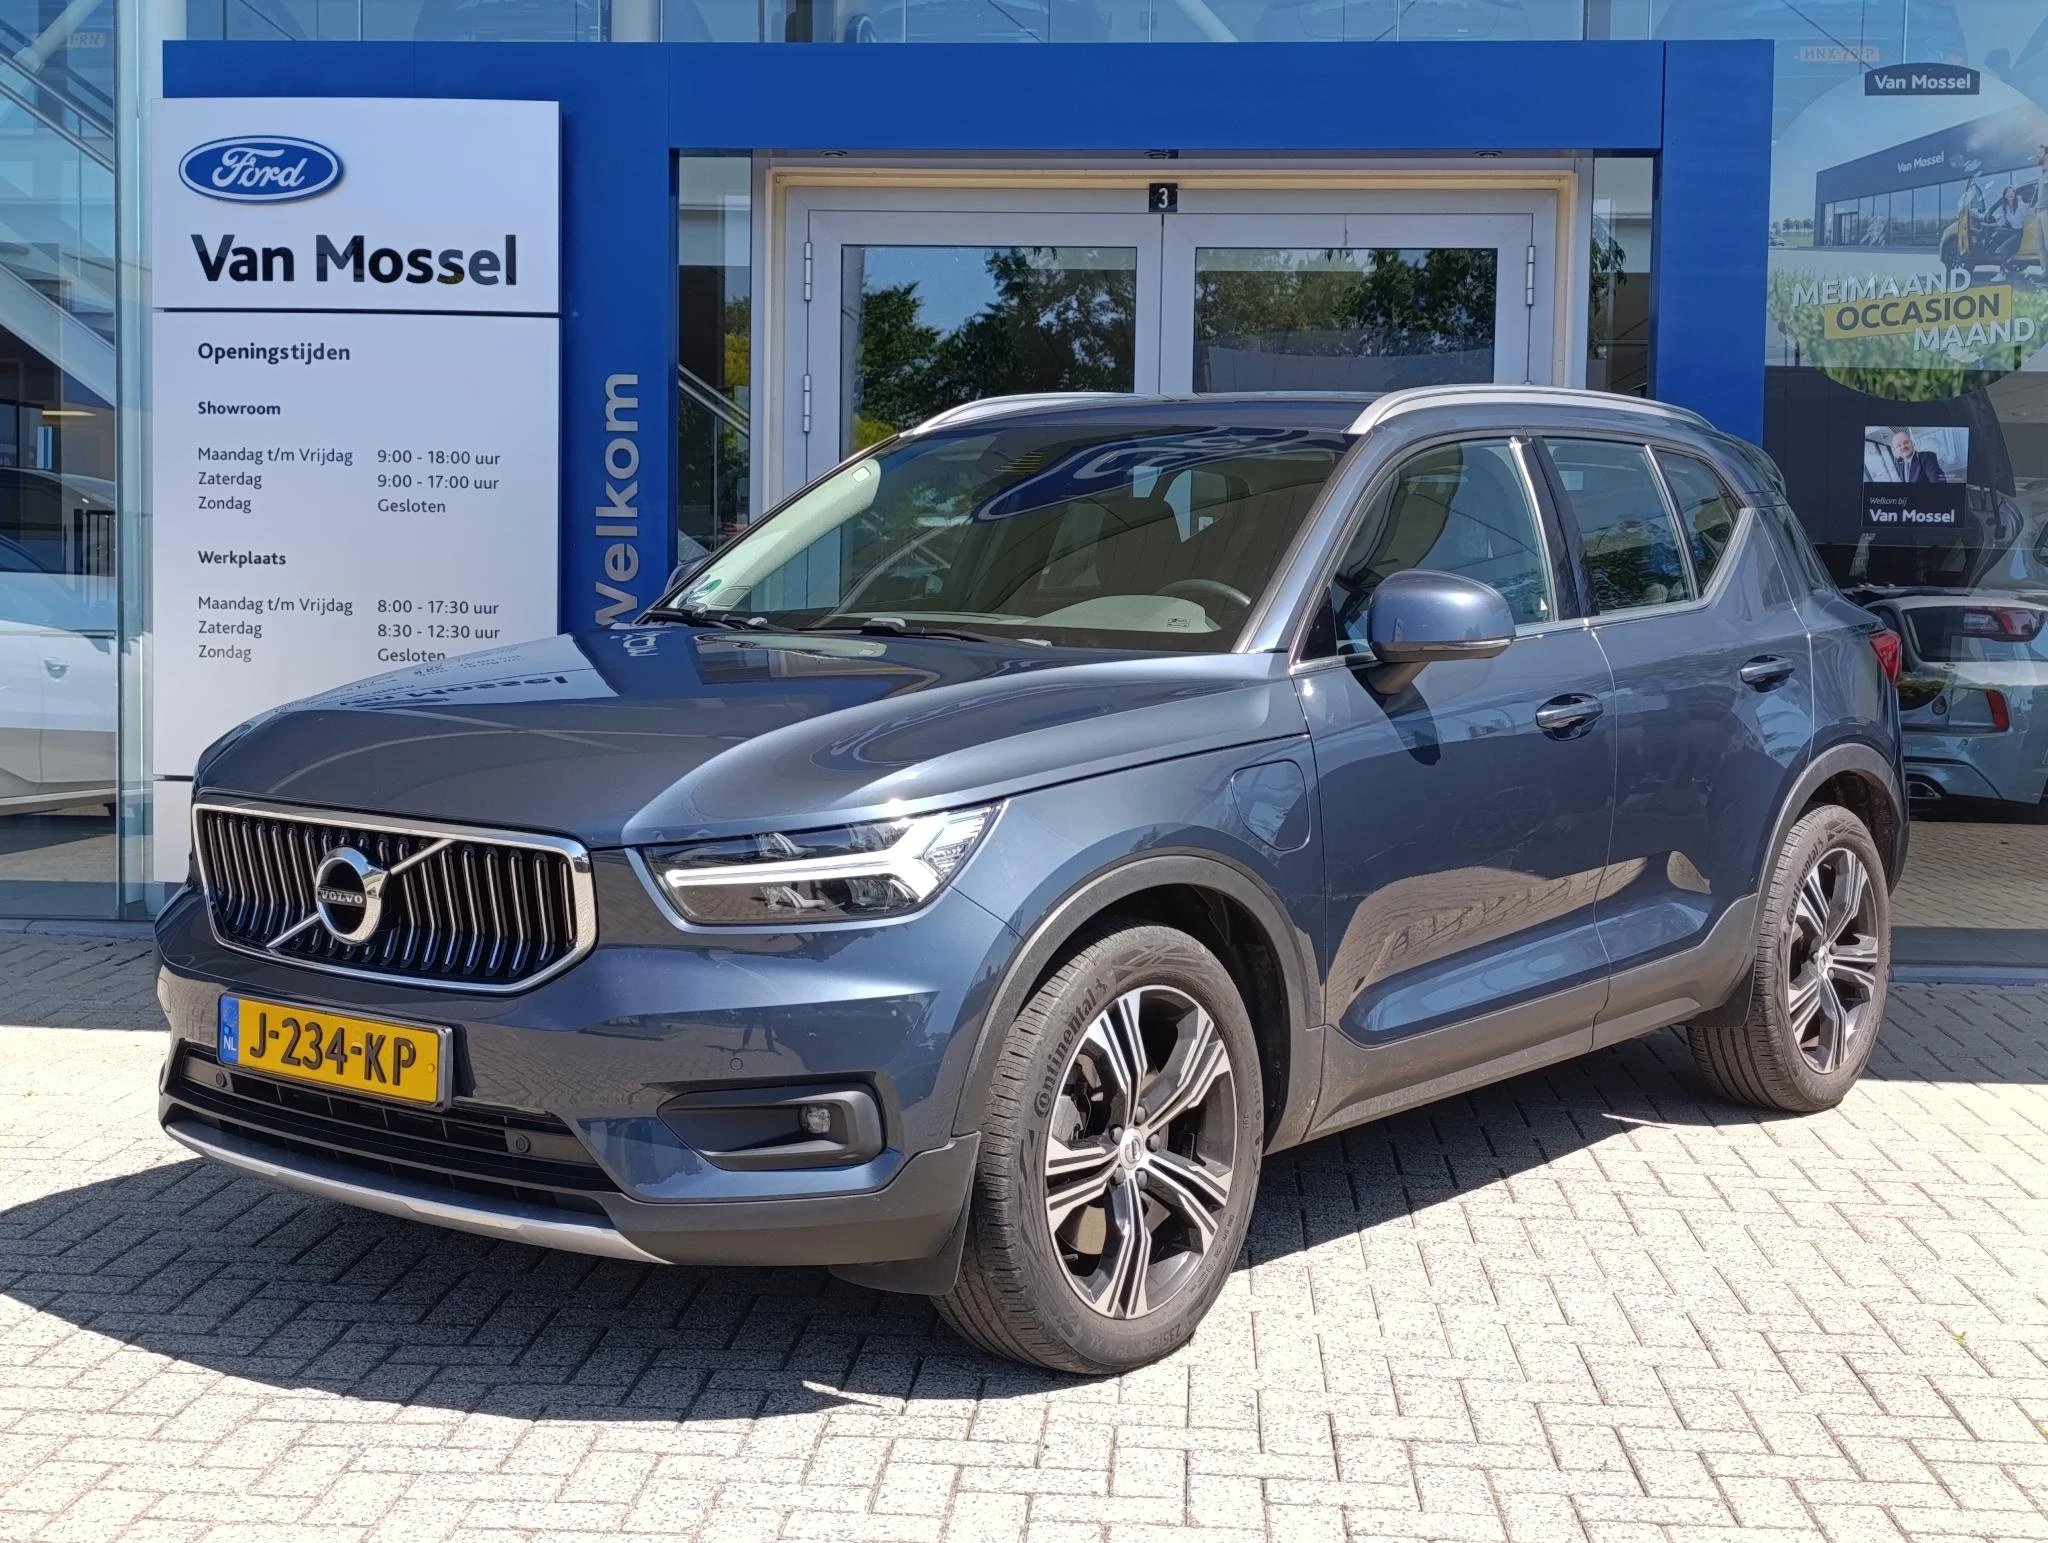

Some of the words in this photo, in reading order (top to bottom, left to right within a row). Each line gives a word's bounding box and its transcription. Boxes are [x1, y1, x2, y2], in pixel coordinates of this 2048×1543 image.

[1874, 74, 1906, 90] Van
[1911, 72, 1972, 90] Mossel
[212, 147, 309, 187] Ford
[1897, 162, 1913, 173] Van
[1913, 150, 1945, 169] Mossel
[1158, 187, 1169, 209] 3
[190, 234, 295, 282] Van
[315, 234, 517, 286] Mossel
[1793, 268, 1972, 308] MEIMAAND
[1836, 293, 2000, 331] OCCASION
[1913, 317, 2037, 351] MAAND
[197, 341, 351, 366] Openingstijden
[197, 401, 281, 416] Showroom
[197, 447, 264, 467] Maandag
[266, 447, 295, 462] t/m
[298, 447, 354, 467] Vrijdag
[377, 449, 413, 464] 9:00
[427, 450, 471, 465] 18:00
[475, 454, 501, 465] uur
[197, 471, 263, 490] Zaterdag
[377, 473, 413, 488] 9:00
[427, 474, 469, 489] 17:00
[473, 479, 500, 490] uur
[197, 495, 252, 514] Zondag
[377, 498, 446, 513] Gesloten
[595, 373, 640, 626] Welkom
[1869, 496, 1897, 505] Welkom
[1897, 496, 1908, 507] bij
[1869, 508, 1898, 522] Van
[1902, 508, 1955, 523] Mossel
[197, 549, 287, 569] Werkplaats
[197, 595, 264, 615] Maandag
[267, 596, 295, 612] t/m
[298, 597, 354, 617] Vrijdag
[377, 599, 413, 614] 8:00
[427, 600, 469, 615] 17:30
[473, 604, 500, 615] uur
[197, 620, 263, 639] Zaterdag
[377, 623, 412, 638] 8:30
[427, 624, 470, 639] 12:30
[474, 628, 501, 639] uur
[197, 644, 252, 663] Zondag
[377, 648, 446, 663] Gesloten
[1787, 842, 1820, 926] Continental
[320, 889, 363, 904] VOLVO
[223, 1034, 237, 1052] NL
[249, 1012, 417, 1087] J-234-KP
[1034, 987, 1098, 1119] Continental
